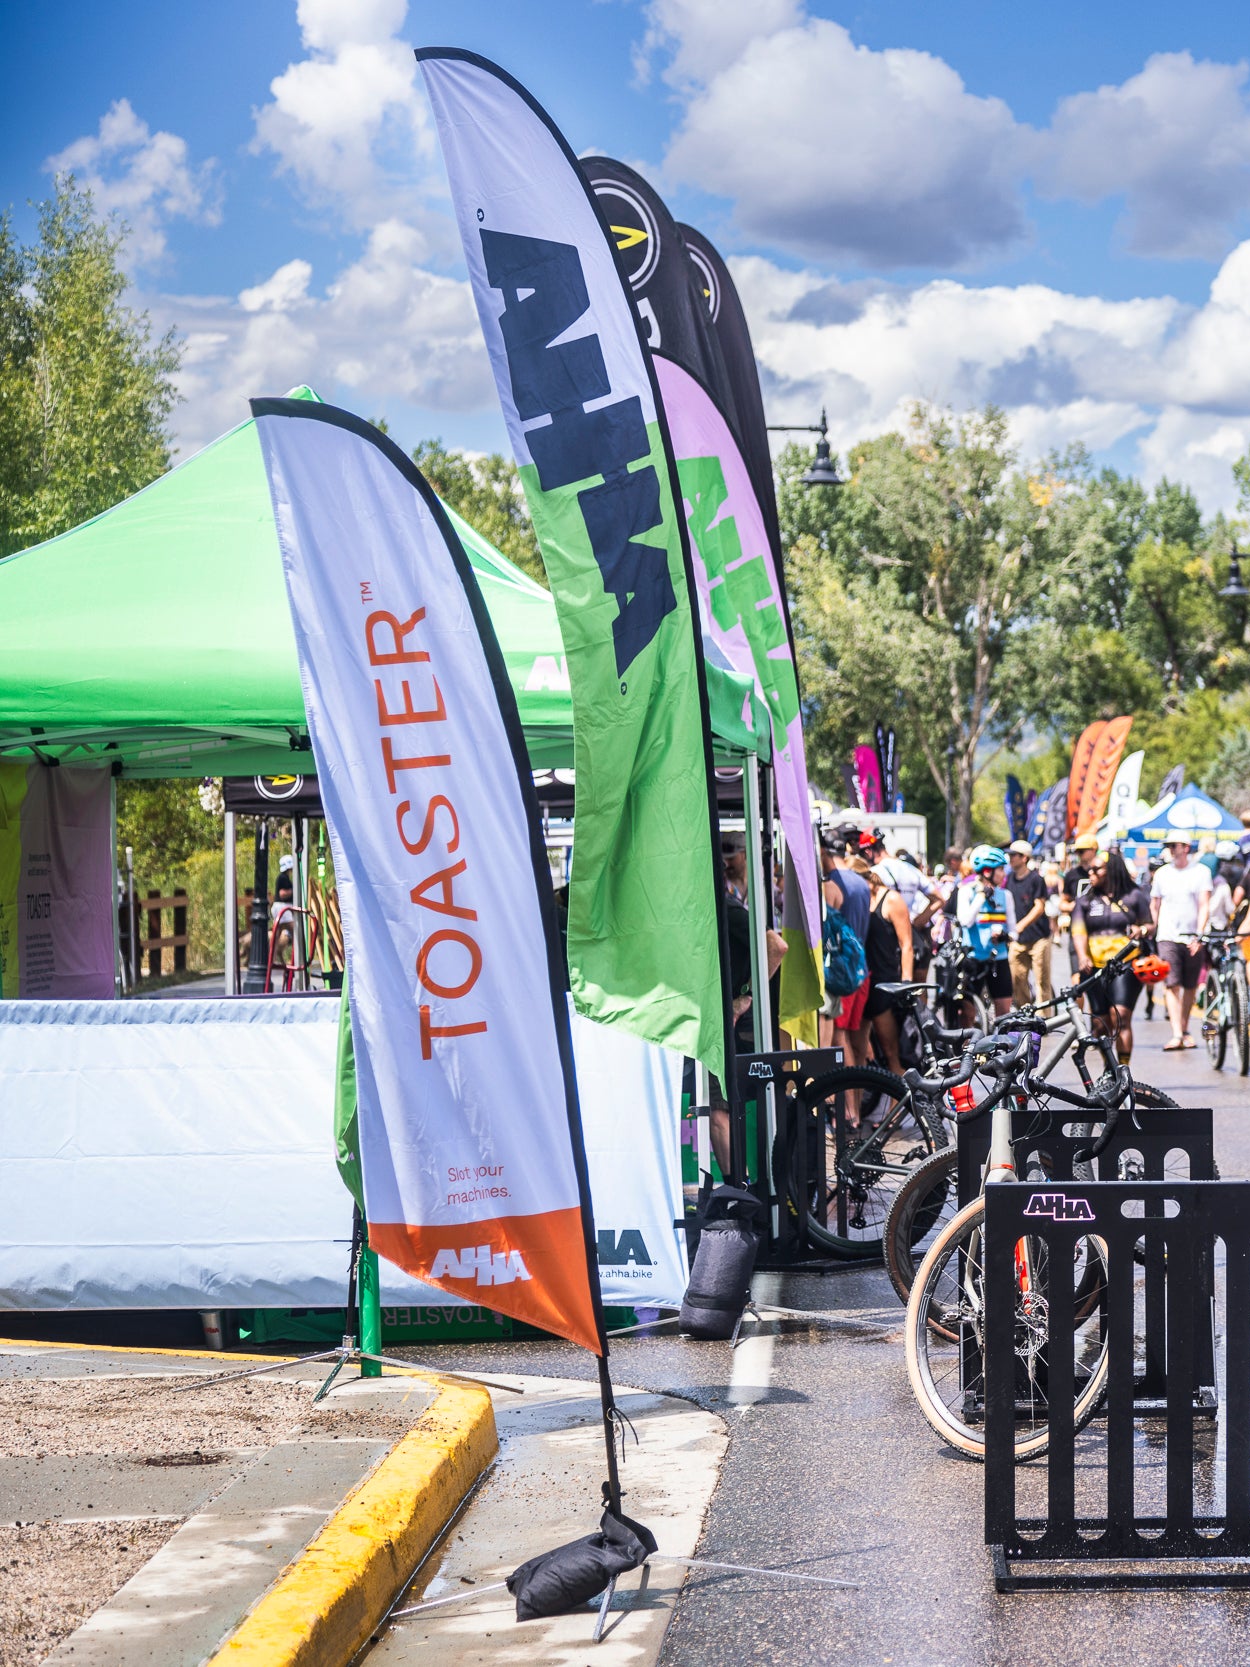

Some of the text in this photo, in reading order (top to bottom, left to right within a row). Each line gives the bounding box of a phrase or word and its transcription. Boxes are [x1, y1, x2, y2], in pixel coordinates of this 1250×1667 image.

[26, 893, 52, 920] TOASTER
[447, 1164, 505, 1183] Slot your
[446, 1185, 512, 1206] machines.
[1024, 1193, 1096, 1222] AHHA
[425, 1243, 533, 1287] AHHA
